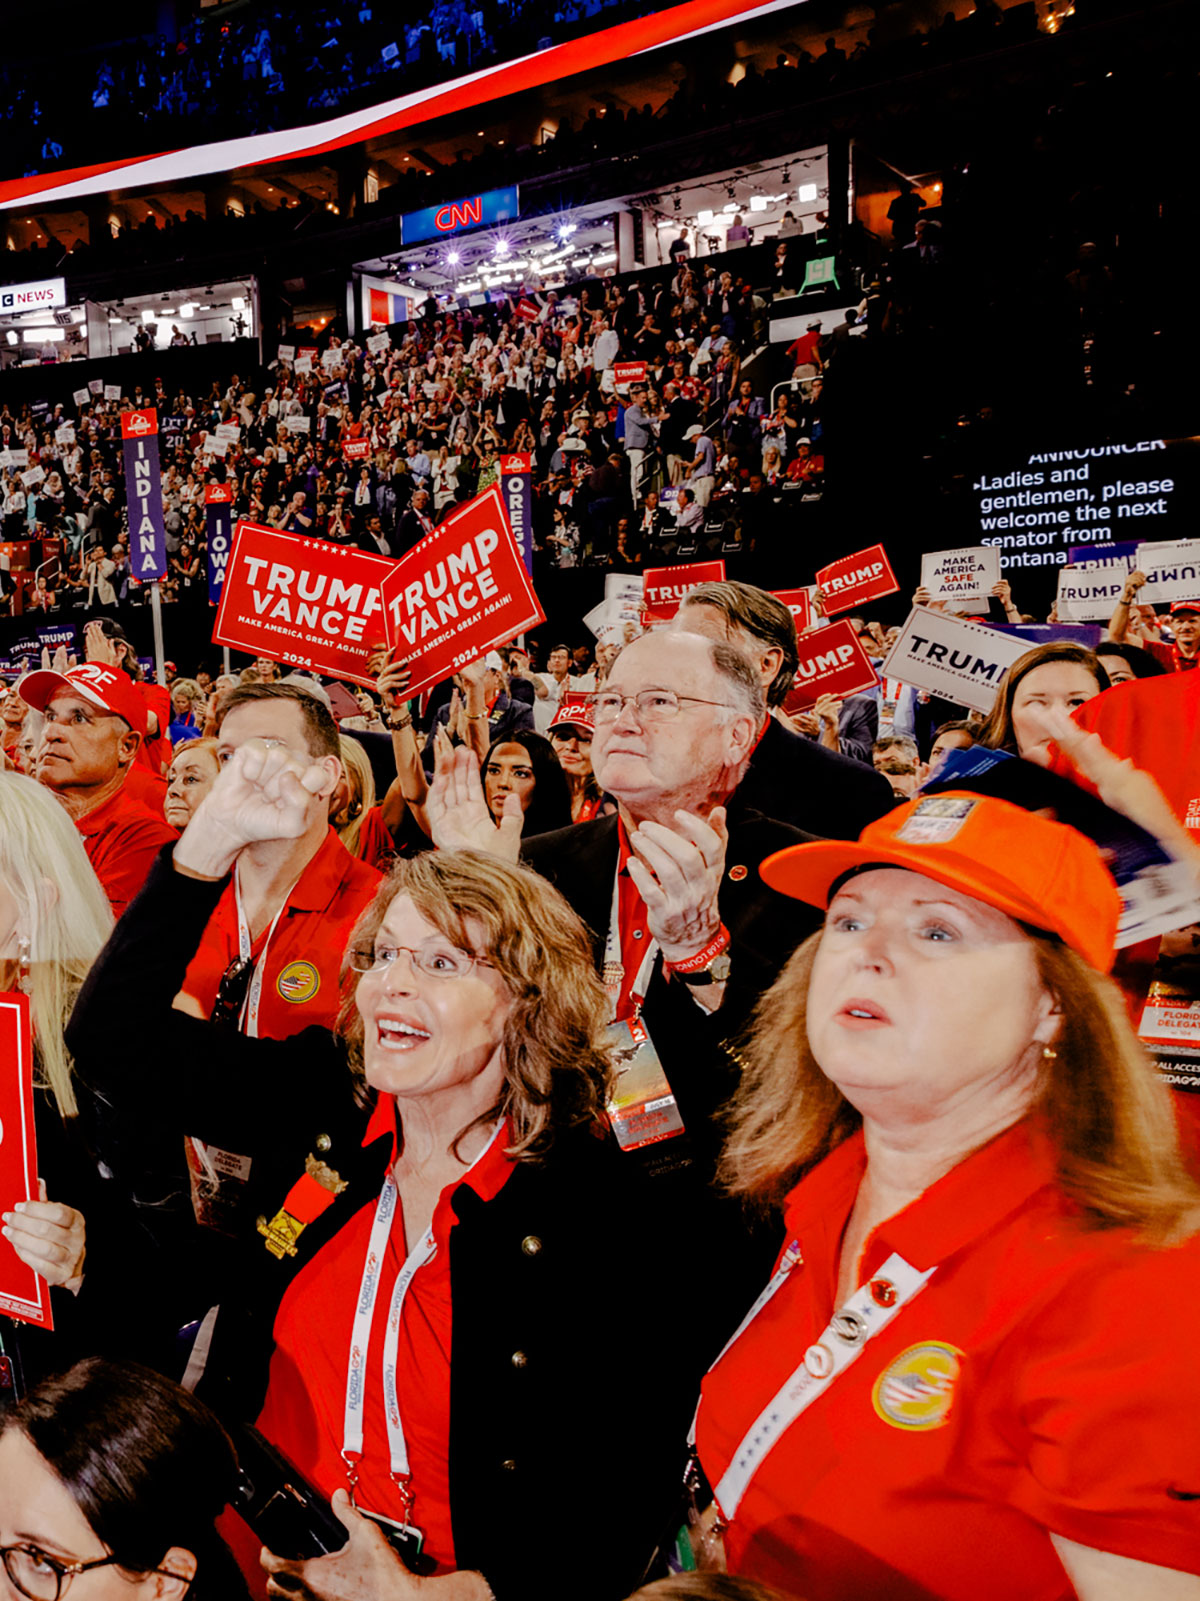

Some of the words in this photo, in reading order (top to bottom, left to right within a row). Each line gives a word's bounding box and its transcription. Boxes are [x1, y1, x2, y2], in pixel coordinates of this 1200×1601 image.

[434, 197, 482, 232] CNN
[17, 289, 54, 303] NEWS
[55, 314, 71, 325] 115
[617, 367, 644, 377] TRUMP
[981, 471, 1044, 490] Ladies
[1050, 464, 1089, 483] and
[980, 487, 1095, 514] gentlemen,
[1102, 478, 1175, 501] please
[134, 441, 159, 572] INDIANA
[981, 510, 1070, 531] welcome
[1075, 504, 1111, 520] the
[1117, 498, 1168, 518] next
[507, 476, 525, 557] OREG
[980, 531, 1058, 549] senator
[1061, 526, 1112, 544] from
[210, 519, 230, 585] IOWA
[942, 555, 975, 566] MAKE
[999, 551, 1068, 569] ontana
[388, 528, 500, 627] TRUMP
[821, 562, 884, 594] TRUMP
[933, 563, 985, 576] AMERICA
[944, 573, 973, 584] SAFE
[1146, 567, 1200, 583] UMP
[243, 555, 383, 617] TRUMP
[646, 581, 703, 601] TRU
[939, 581, 980, 593] AGAIN!
[1060, 585, 1122, 599] TRUMP
[400, 567, 500, 646] VANCE
[252, 589, 368, 643] VANCE
[423, 629, 457, 654] AMERICA
[456, 611, 483, 633] GREAT
[484, 593, 513, 617] AGAIN!
[39, 631, 74, 644] TRUMP
[238, 615, 262, 628] MAKE
[264, 622, 303, 640] AMERICA
[305, 634, 335, 648] GREAT
[336, 643, 369, 657] AGAIN!
[10, 641, 40, 654] TRUMP
[282, 652, 312, 667] 2024
[452, 646, 479, 668] 2024
[793, 644, 855, 683] UMP
[927, 661, 957, 675] AMERICA
[981, 680, 998, 690] AGA
[932, 688, 955, 700] 2024
[707, 941, 721, 955] 168
[675, 948, 709, 971] LOUNG
[1157, 1019, 1200, 1029] DELEGAT
[1164, 1011, 1200, 1021] FLORID
[632, 1028, 645, 1042] 2
[1158, 1062, 1173, 1071] ALL
[1174, 1063, 1200, 1073] ACCES
[215, 1157, 242, 1171] DELEGATE
[217, 1151, 240, 1163] FLORIDA
